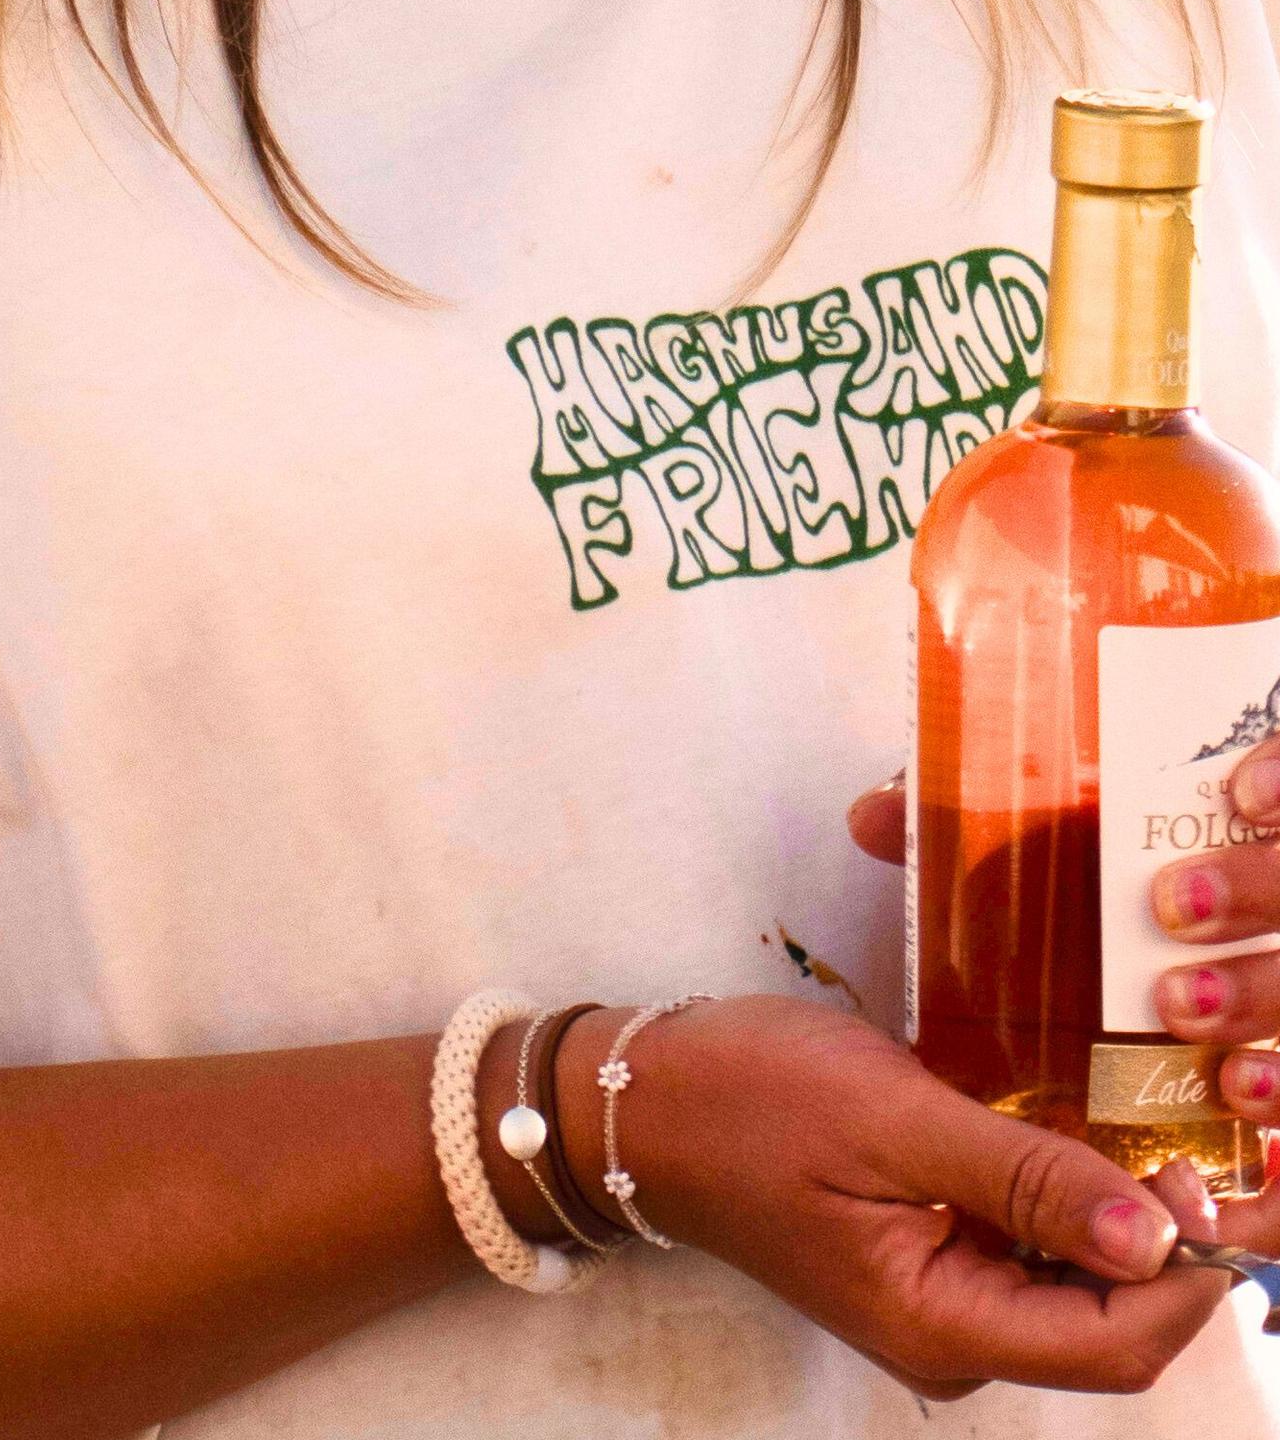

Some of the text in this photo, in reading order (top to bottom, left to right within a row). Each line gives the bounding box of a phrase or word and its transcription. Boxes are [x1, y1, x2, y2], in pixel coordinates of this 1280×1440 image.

[506, 247, 1048, 484] MAGNUS AND
[536, 360, 1042, 612] FRIEN
[1134, 1060, 1207, 1106] Late
